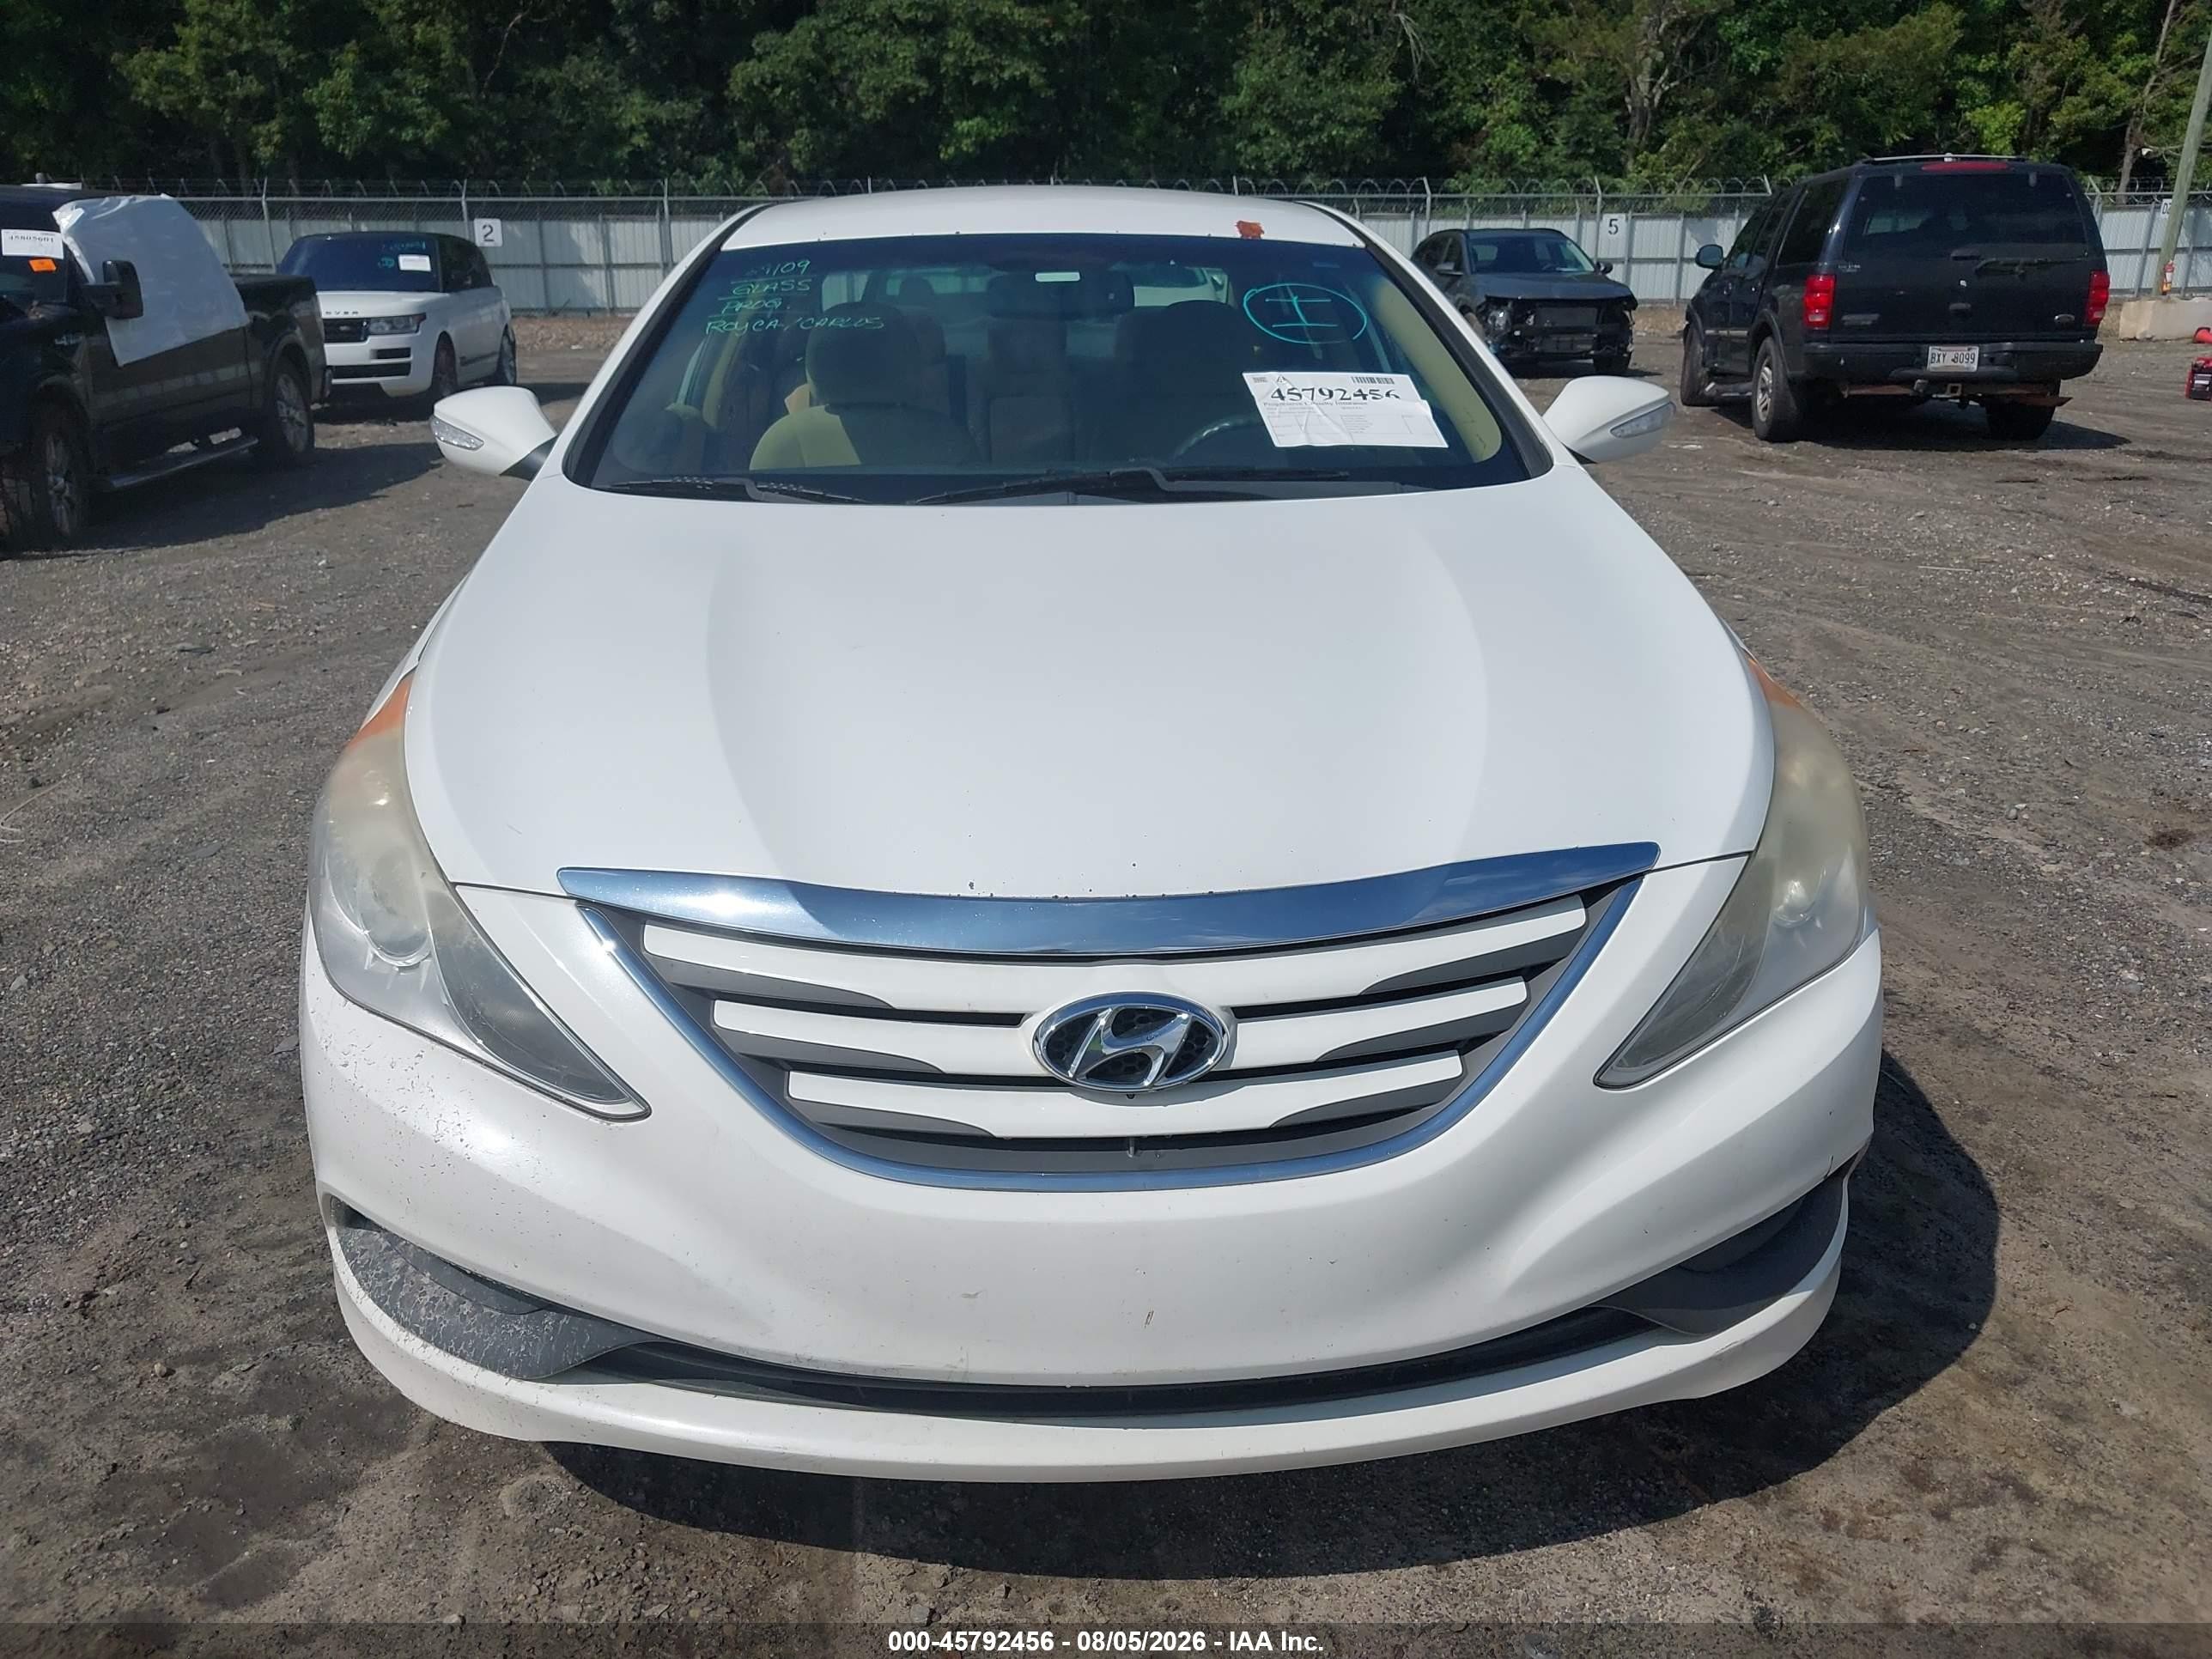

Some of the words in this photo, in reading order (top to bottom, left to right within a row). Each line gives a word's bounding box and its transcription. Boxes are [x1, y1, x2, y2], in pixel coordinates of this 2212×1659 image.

[482, 224, 495, 241] 2
[1608, 218, 1619, 235] 5
[732, 278, 812, 295] GLASS
[1930, 352, 1947, 364] BXY
[1271, 386, 1401, 401] 45792456
